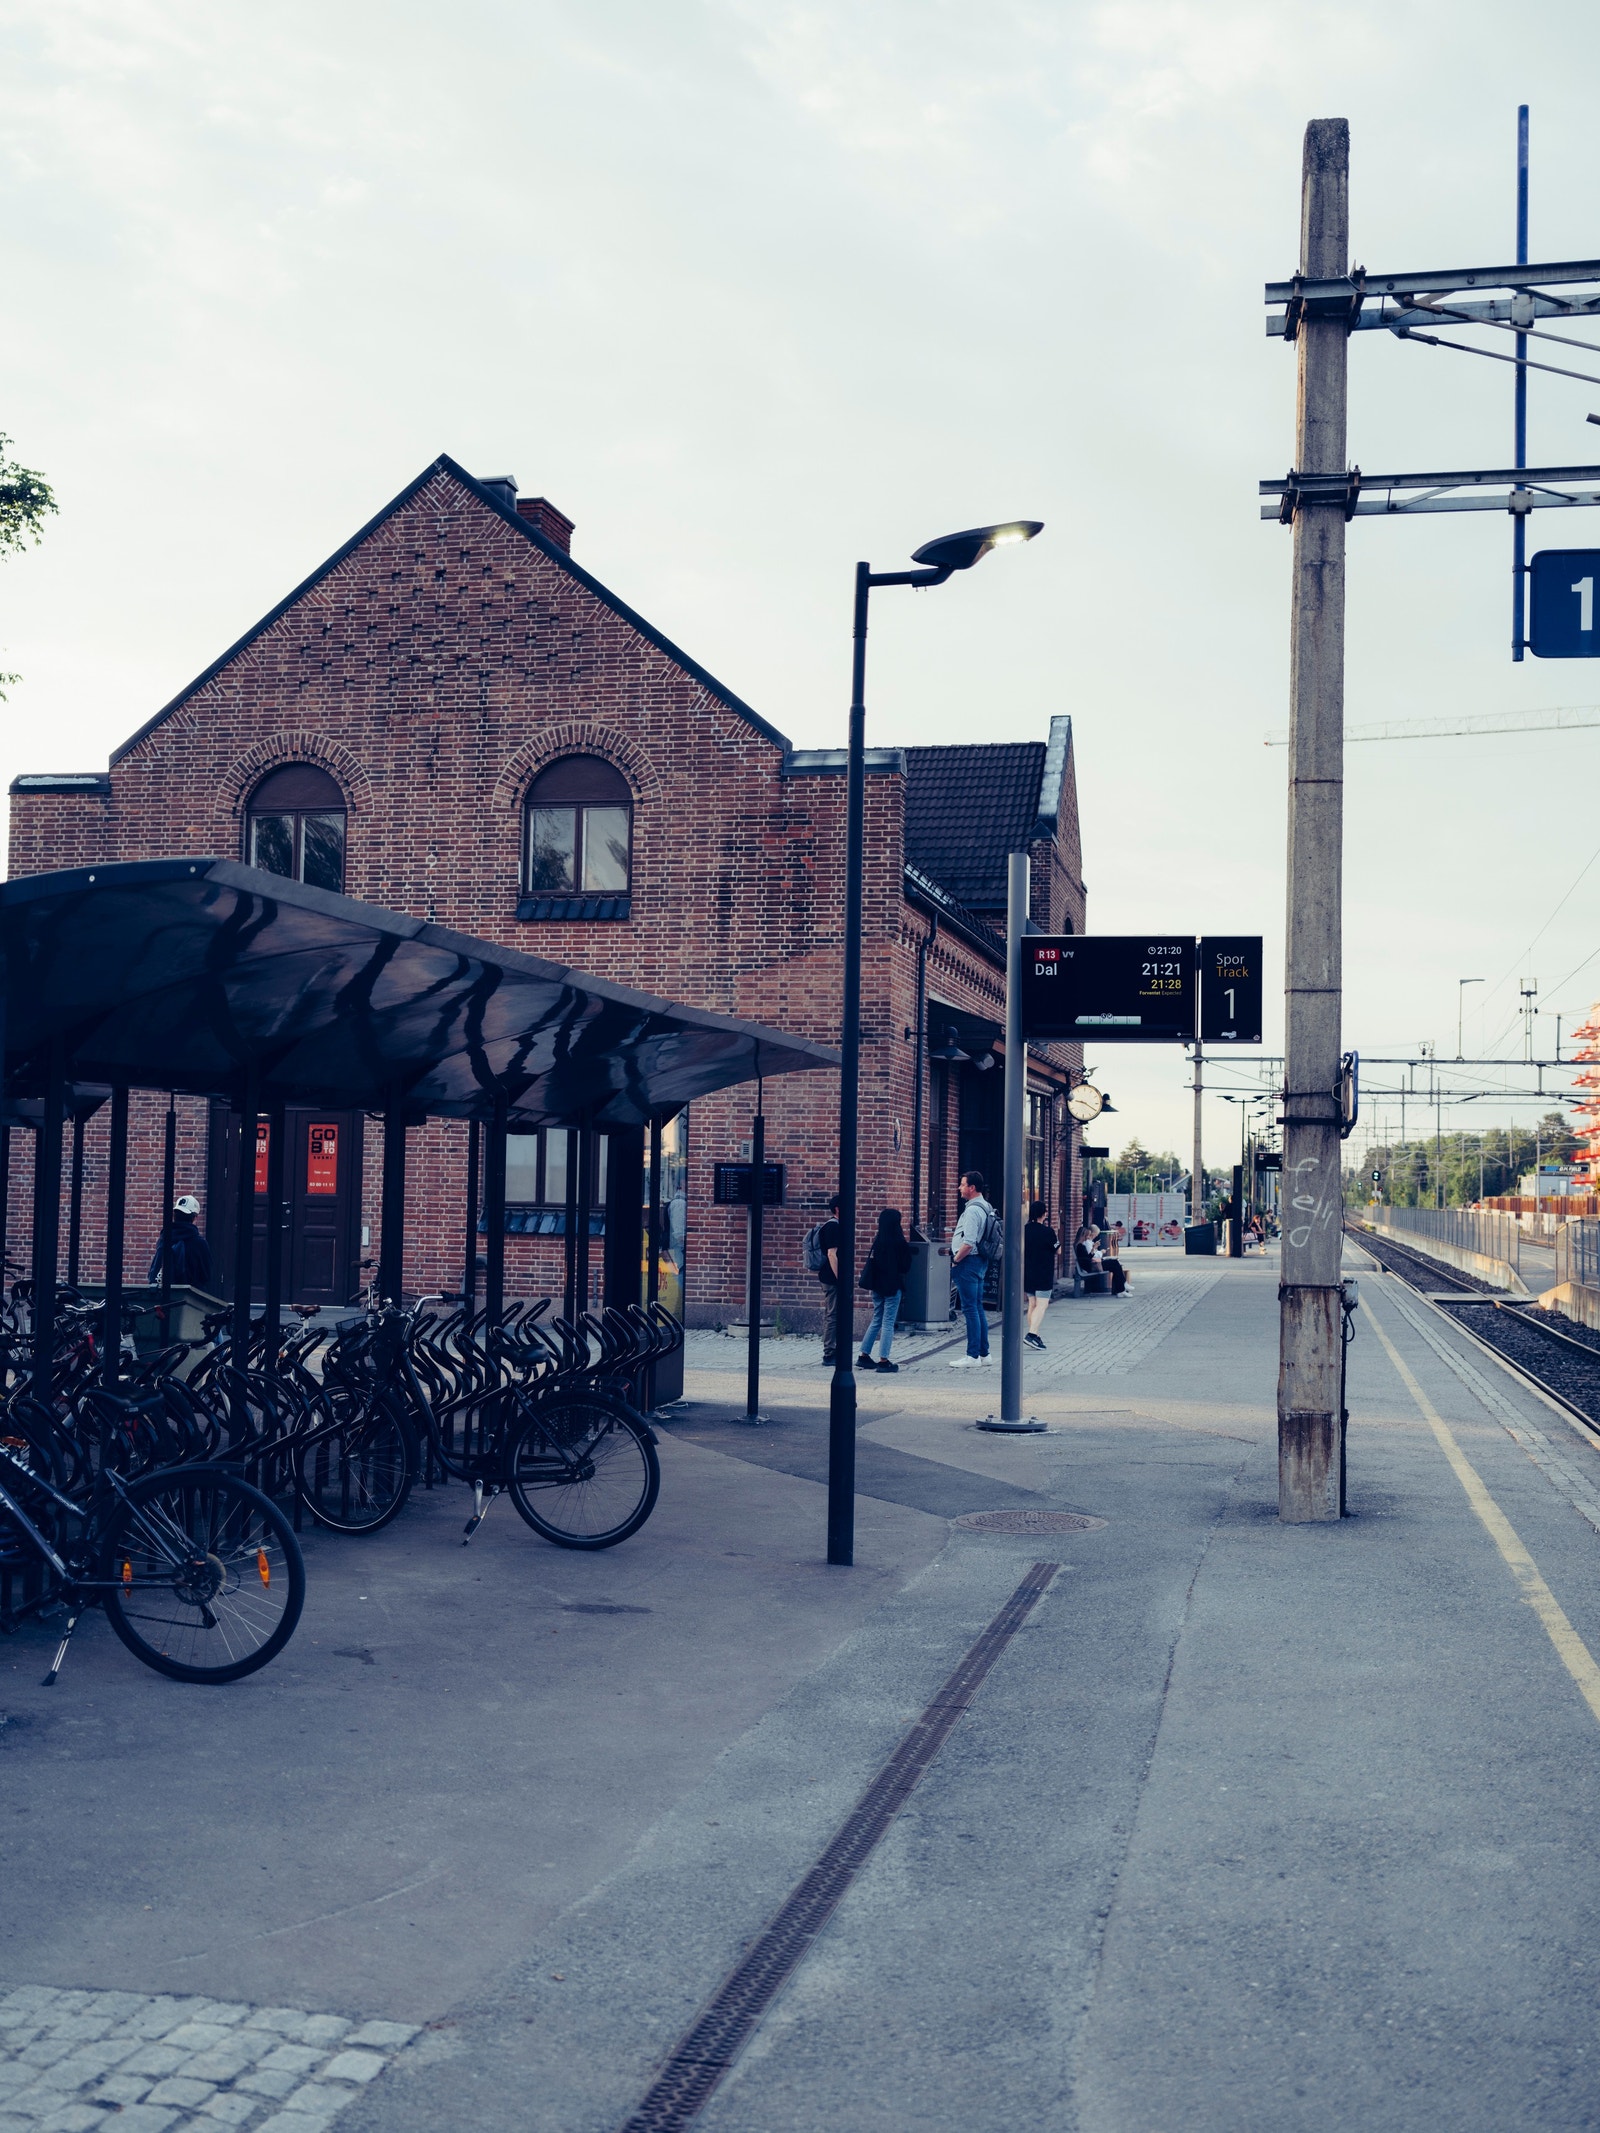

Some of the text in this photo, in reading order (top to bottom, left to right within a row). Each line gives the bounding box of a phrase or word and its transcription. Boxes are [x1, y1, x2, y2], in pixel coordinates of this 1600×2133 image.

[1571, 577, 1594, 631] 1
[1157, 946, 1182, 955] 21:20
[1216, 953, 1245, 967] Spor
[1035, 963, 1057, 976] Dal
[1142, 963, 1181, 976] 21:21
[1216, 966, 1249, 977] Track
[1151, 980, 1182, 989] 21:28
[1224, 988, 1235, 1019] 1
[257, 1128, 267, 1139] O
[312, 1129, 336, 1140] GO
